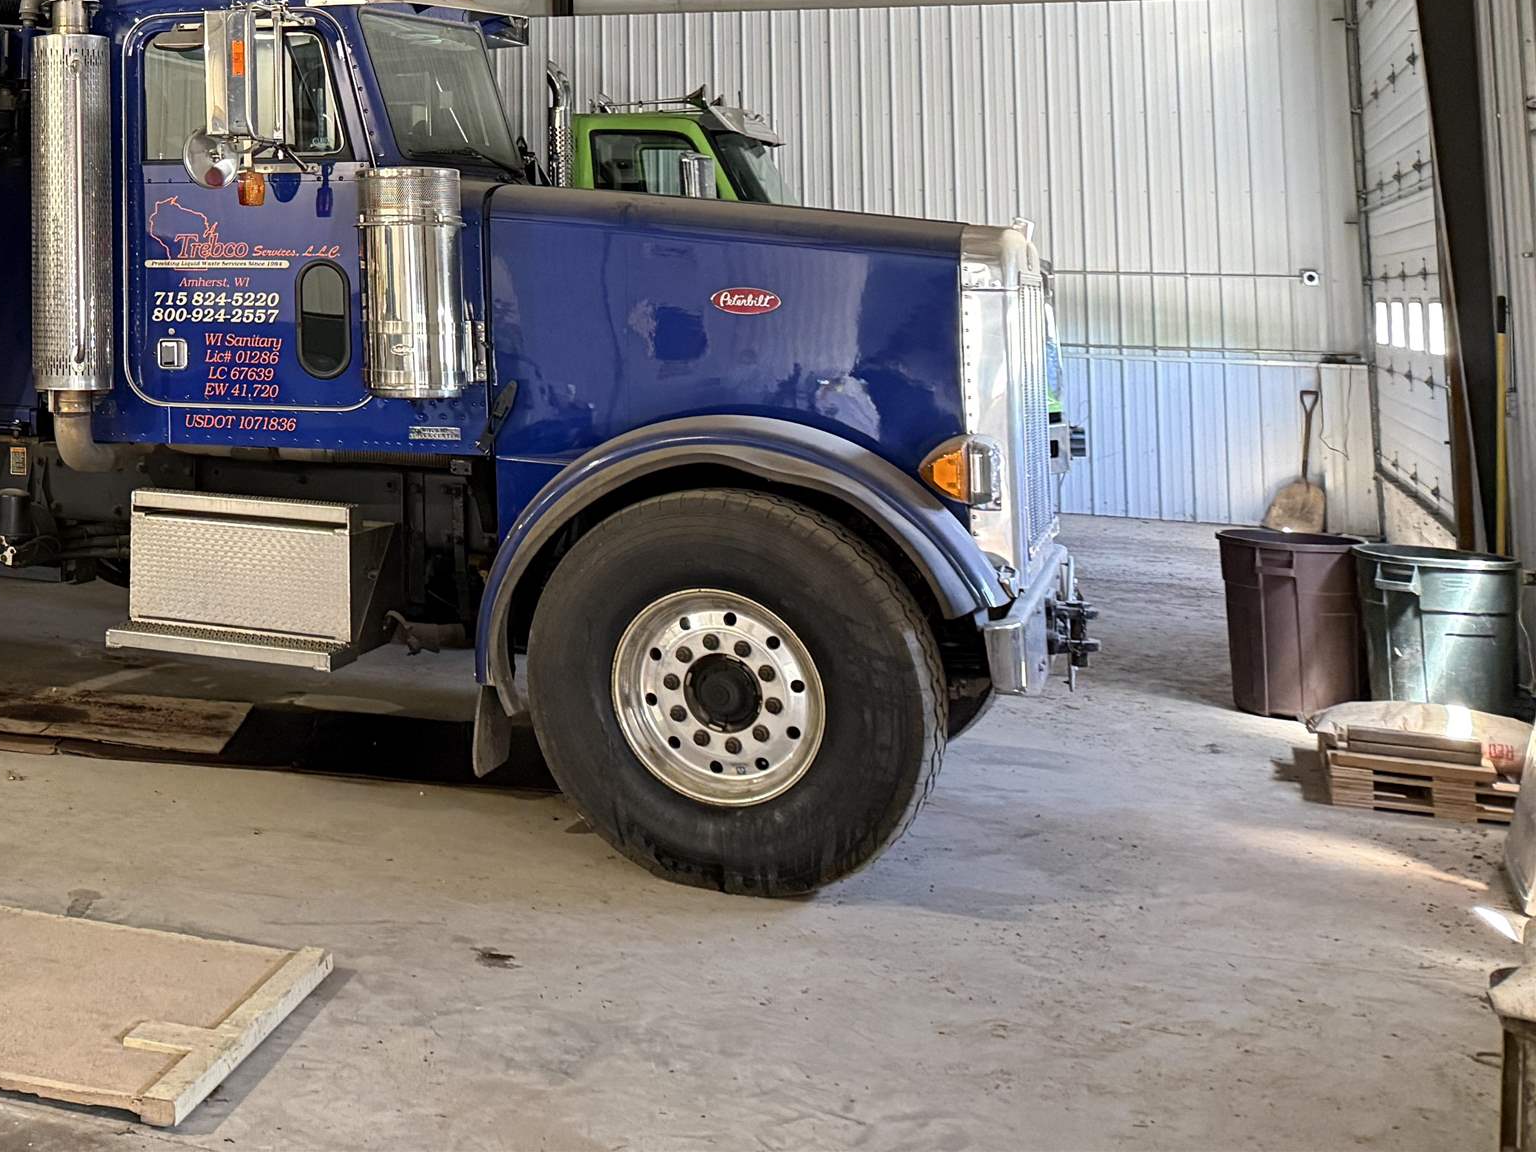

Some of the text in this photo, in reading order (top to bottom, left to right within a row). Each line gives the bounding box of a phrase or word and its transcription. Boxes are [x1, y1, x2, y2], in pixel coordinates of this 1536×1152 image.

[174, 233, 249, 259] Trebco
[234, 277, 250, 287] WI
[154, 291, 280, 307] 715 824-5220
[719, 291, 775, 307] Peterbilt
[151, 307, 280, 324] 800-924-2557
[204, 333, 282, 351] WI Sanitary
[204, 349, 280, 365] Lic# 01286
[208, 366, 274, 381] LC 67639
[204, 382, 228, 396] EW
[185, 414, 297, 431] USDOT 1071836
